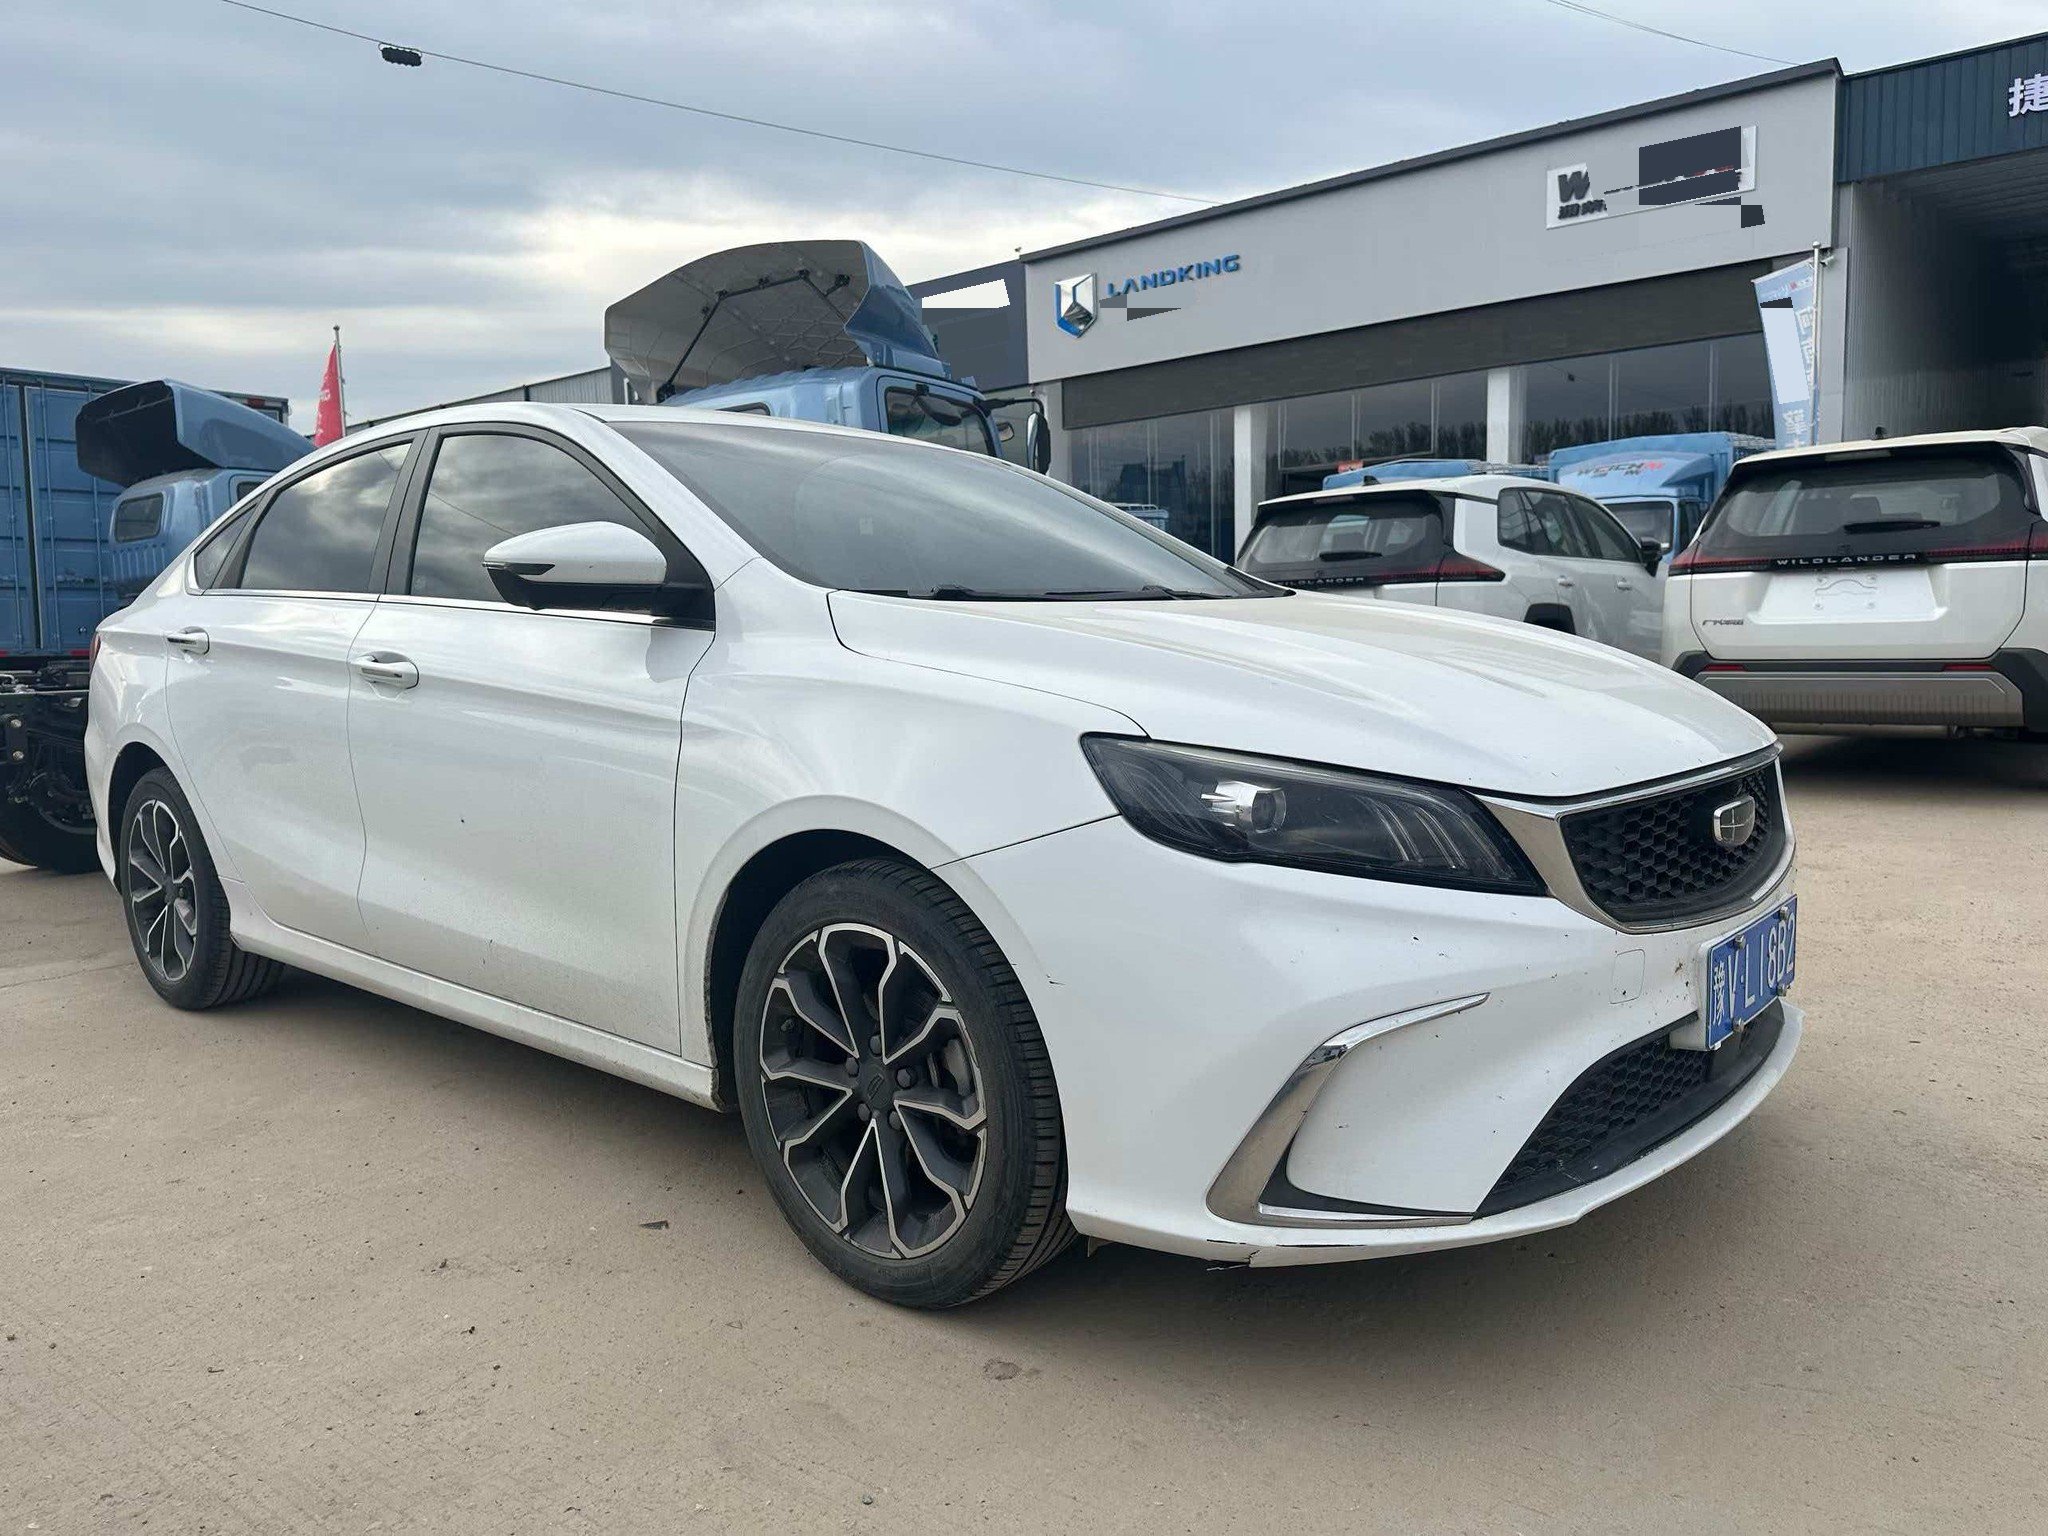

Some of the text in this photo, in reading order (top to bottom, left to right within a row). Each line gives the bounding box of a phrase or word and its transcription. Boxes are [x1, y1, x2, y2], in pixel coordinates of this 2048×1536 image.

[2008, 73, 2048, 117] 捷
[1107, 254, 1241, 297] LANDKING
[1776, 553, 1917, 566] WILDLANDER
